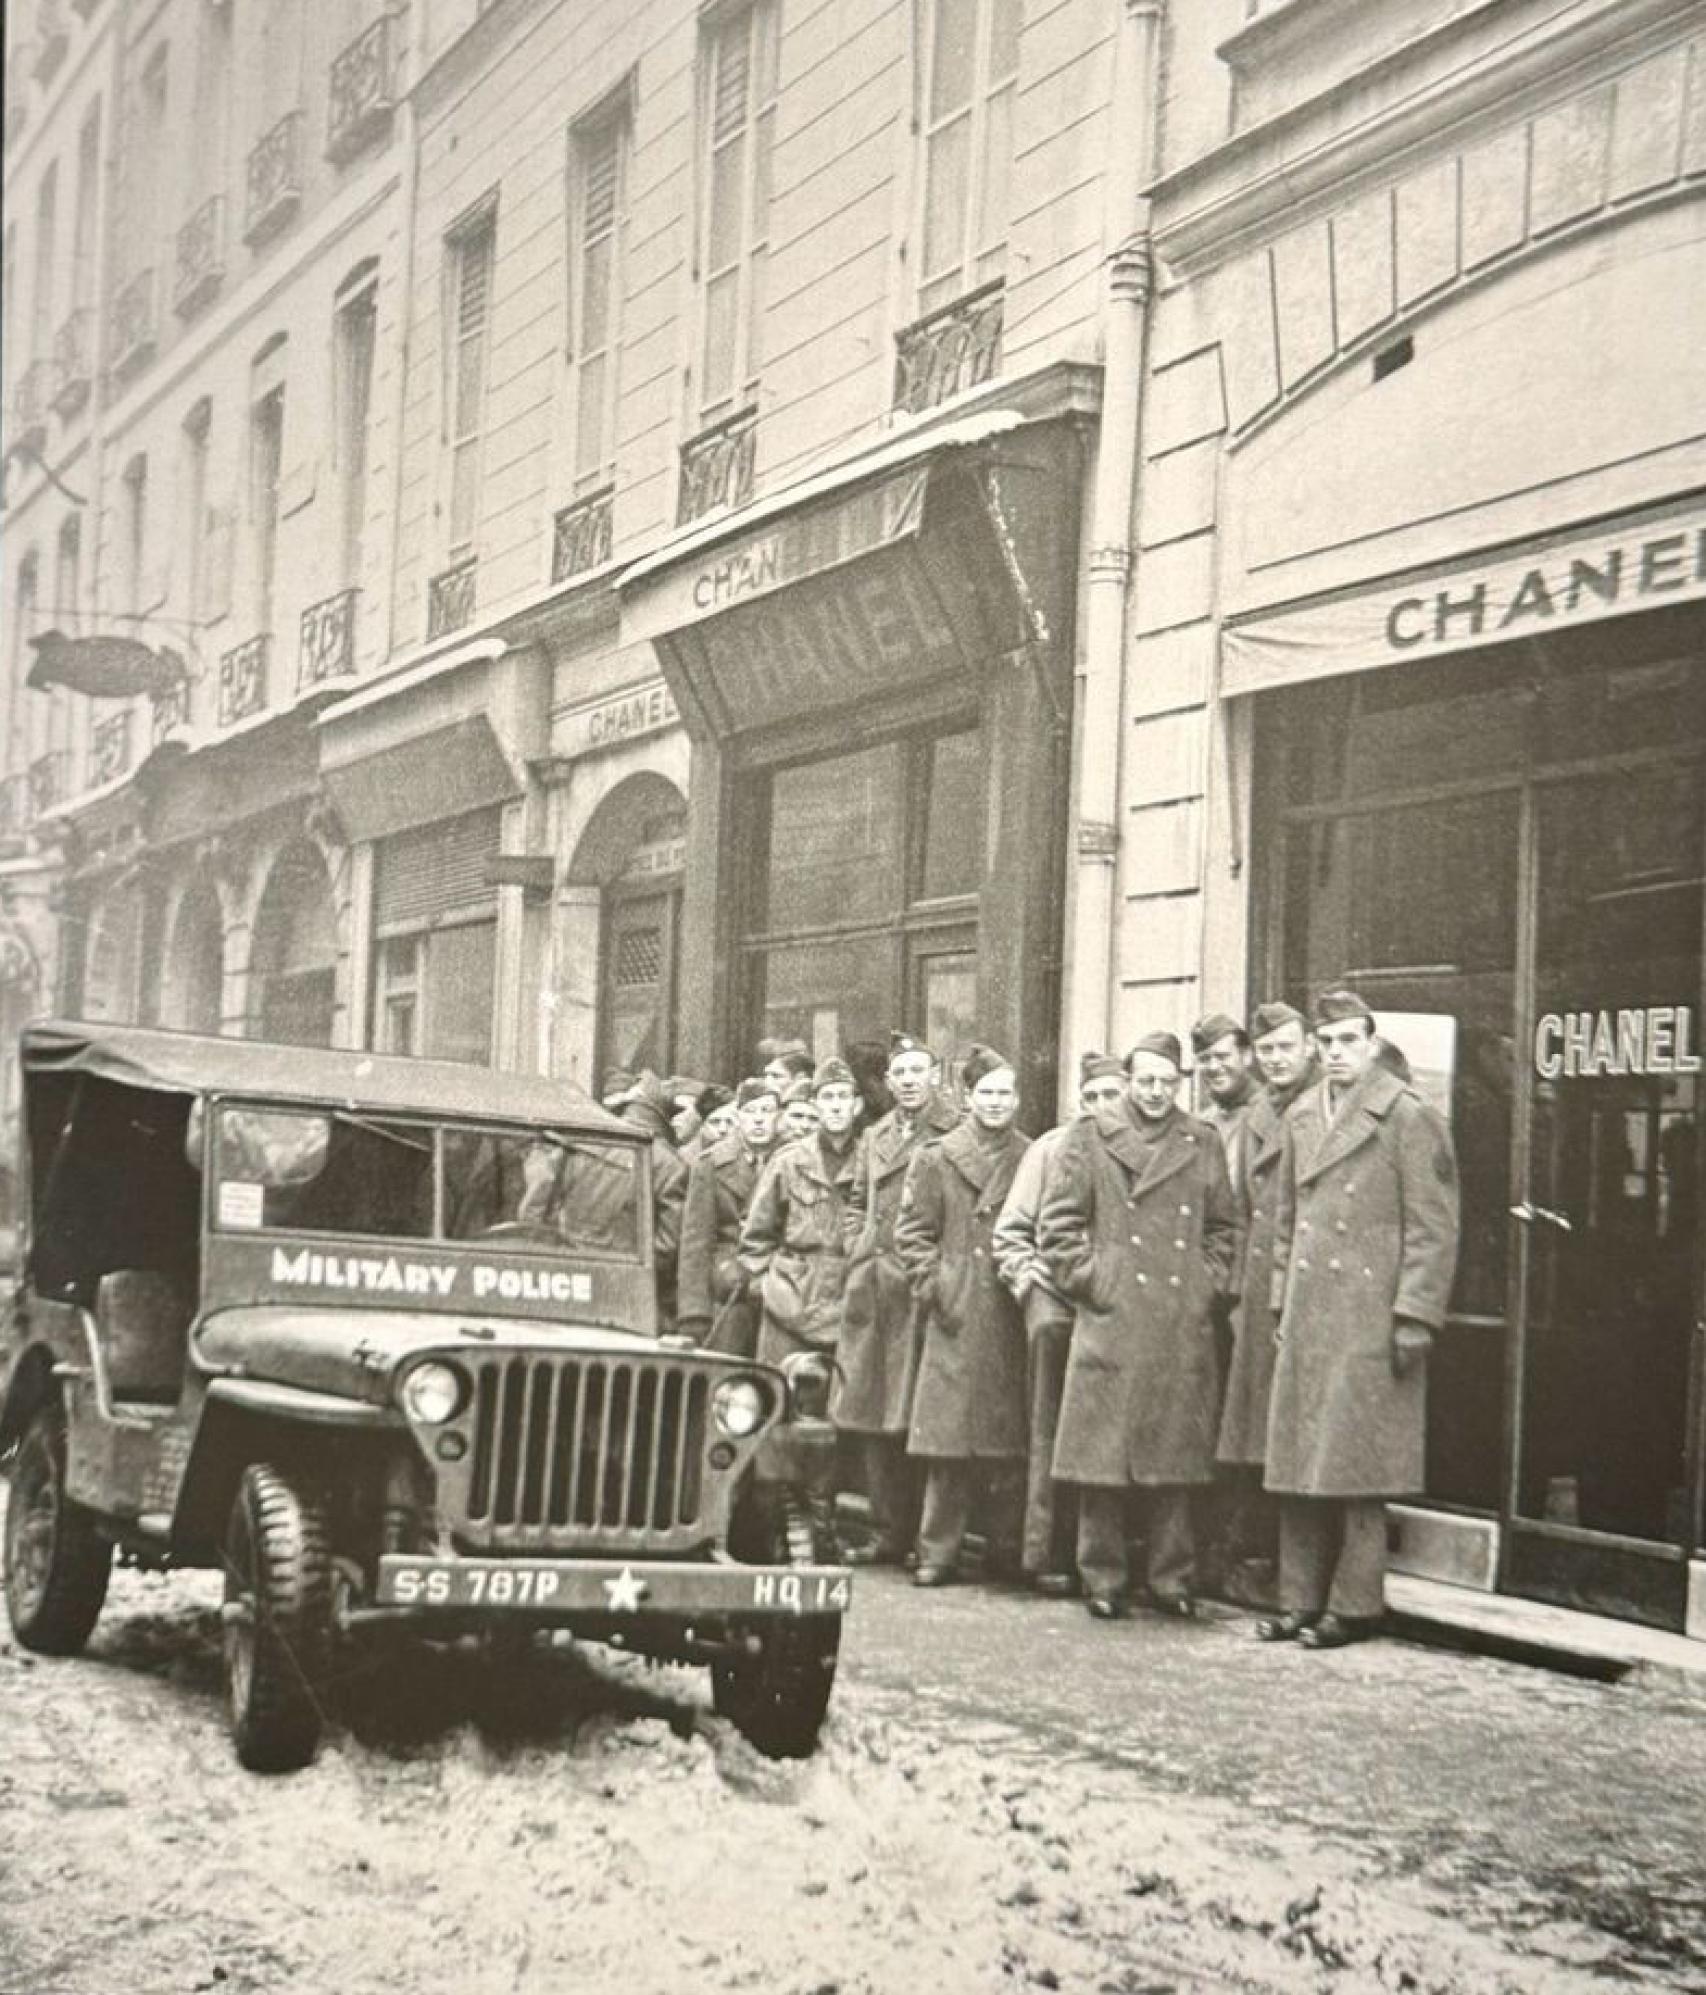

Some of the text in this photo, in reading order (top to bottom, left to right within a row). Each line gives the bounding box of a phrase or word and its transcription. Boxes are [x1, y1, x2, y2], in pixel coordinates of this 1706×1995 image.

[1535, 1006, 1702, 1078] CHANEL
[272, 1247, 593, 1302] MILITARY POLICE
[753, 1574, 802, 1617] HQ
[816, 1577, 849, 1610] 14
